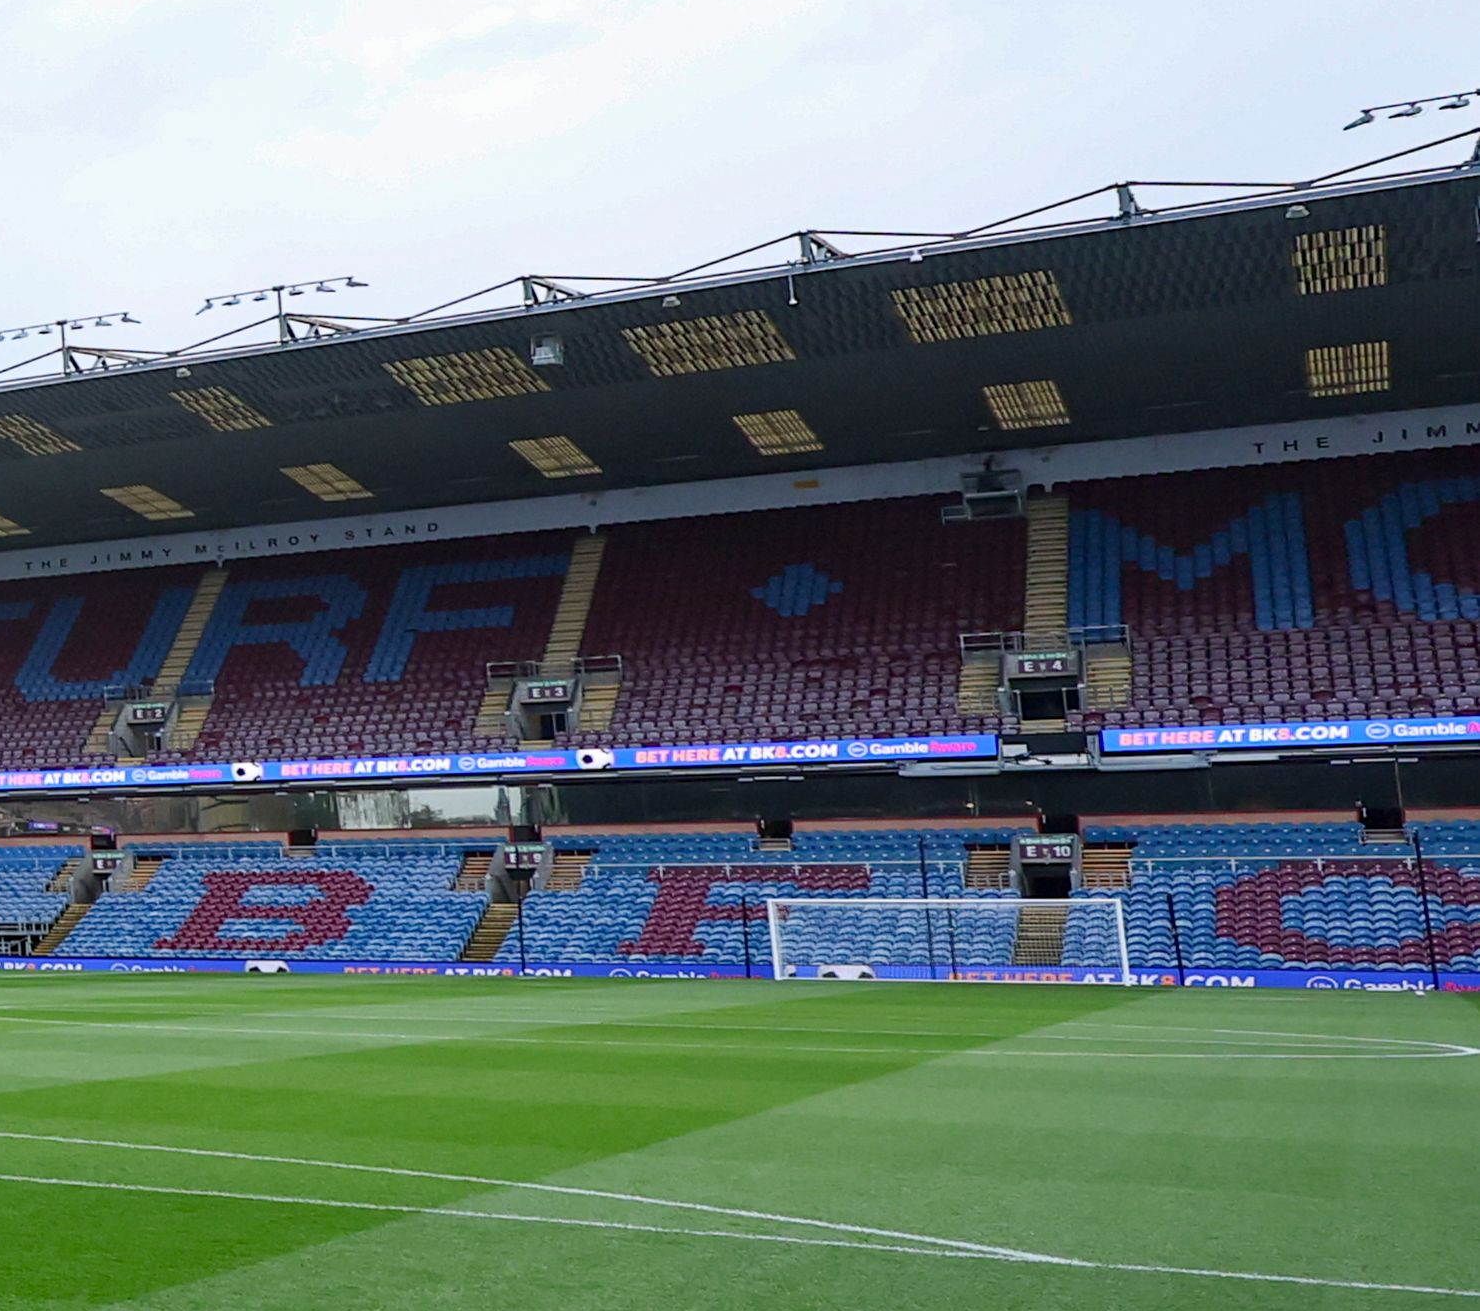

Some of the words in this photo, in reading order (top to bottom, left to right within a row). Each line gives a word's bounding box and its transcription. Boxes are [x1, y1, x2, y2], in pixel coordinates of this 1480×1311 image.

[1253, 436, 1330, 455] THE
[24, 558, 69, 572] THE
[89, 548, 173, 565] JIMMY
[344, 521, 439, 541] STAND
[1024, 661, 1035, 672] E
[1052, 660, 1063, 671] 4
[531, 688, 540, 698] E
[136, 709, 144, 719] E
[1119, 731, 1158, 746] BET
[1160, 729, 1215, 745] HERE
[1217, 729, 1246, 743] AT
[1249, 725, 1349, 742] BK8.COM
[635, 750, 669, 764] BET
[671, 748, 720, 763] HERE
[722, 746, 748, 761] AT
[750, 744, 838, 760] BK8.COM
[280, 763, 309, 777] BET
[311, 762, 352, 775] HERE
[353, 760, 375, 774] AT
[376, 758, 451, 773] BK8.COM
[8, 773, 43, 786] HERE
[44, 772, 61, 785] AT
[1026, 846, 1035, 857] E
[1053, 846, 1071, 857] 10
